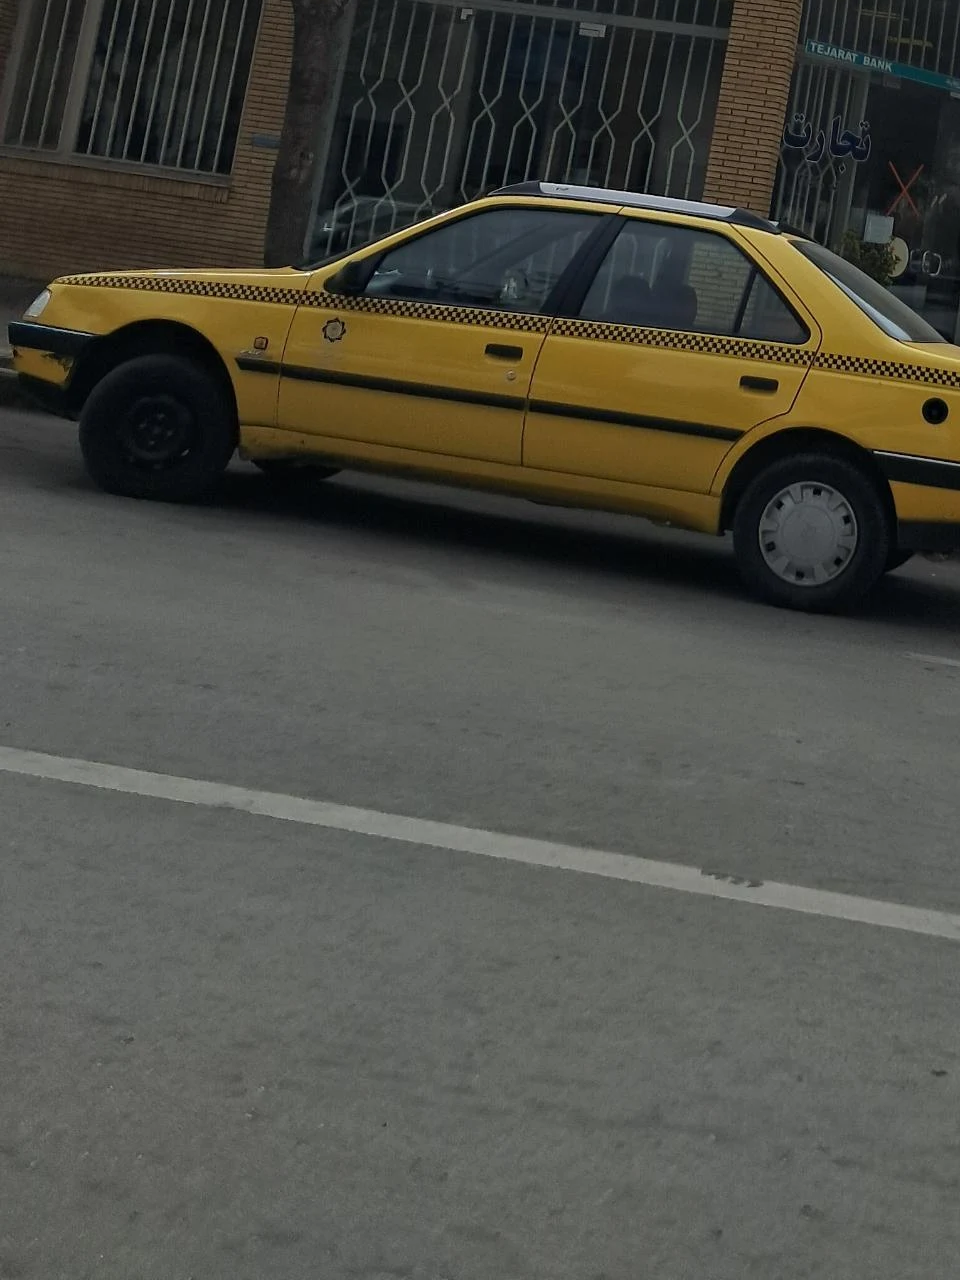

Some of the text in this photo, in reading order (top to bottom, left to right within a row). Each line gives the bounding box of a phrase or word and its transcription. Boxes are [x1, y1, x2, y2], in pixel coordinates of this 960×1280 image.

[810, 41, 893, 72] TEJARAT BANK
[783, 112, 872, 173] تجارت
